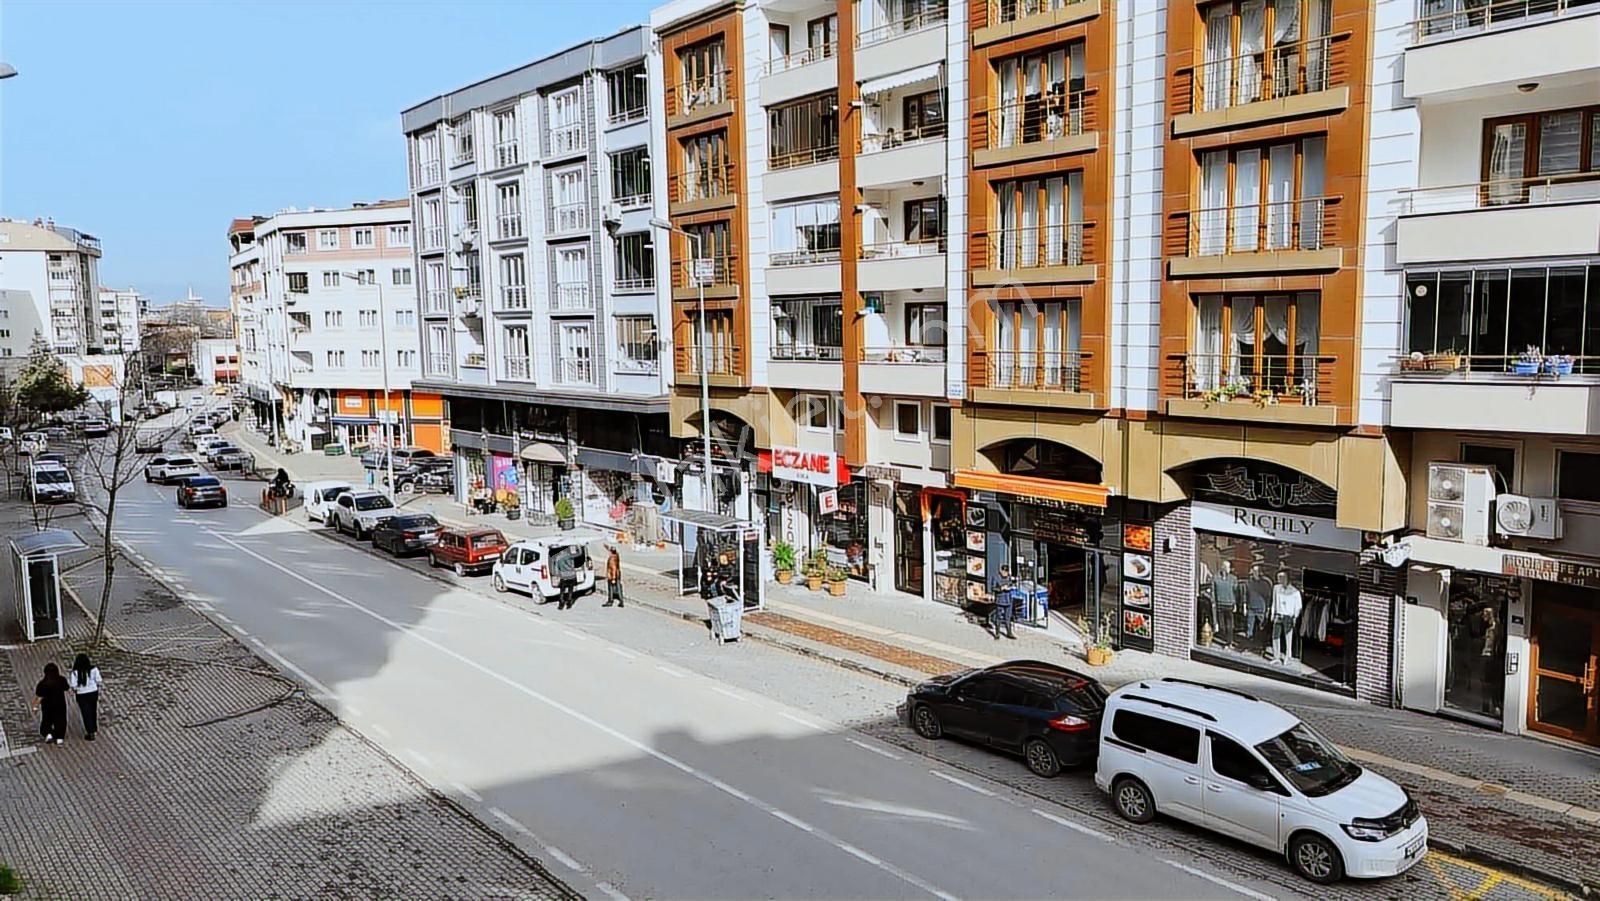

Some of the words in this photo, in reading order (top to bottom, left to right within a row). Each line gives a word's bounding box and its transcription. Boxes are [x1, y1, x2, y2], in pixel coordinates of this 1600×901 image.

[774, 449, 831, 475] ECZANE
[825, 495, 834, 509] E
[1234, 507, 1315, 535] RICHLY
